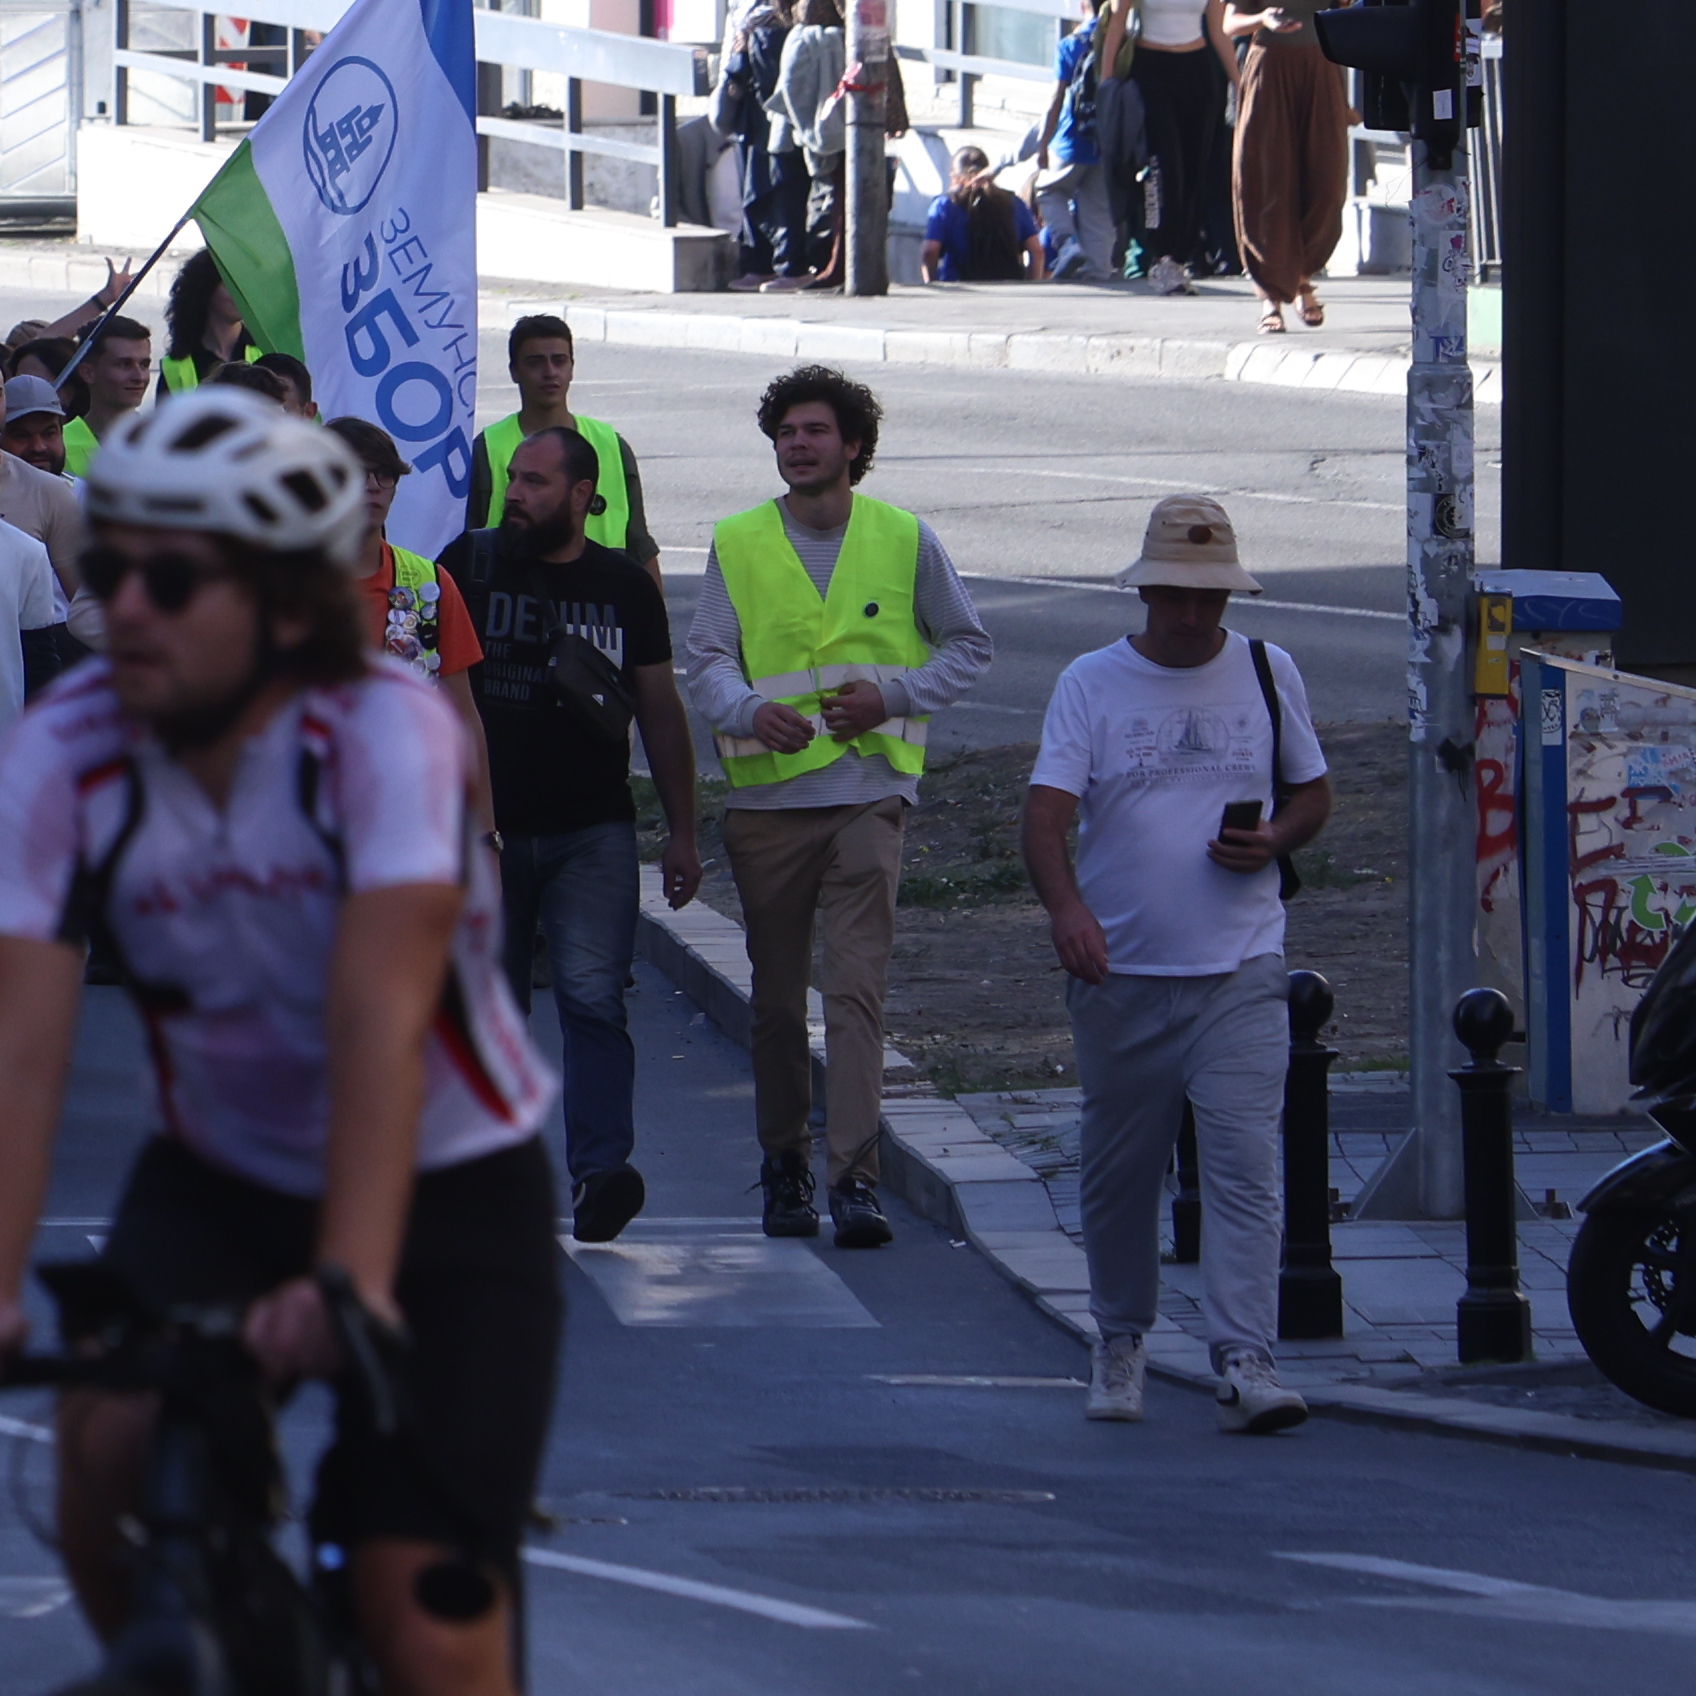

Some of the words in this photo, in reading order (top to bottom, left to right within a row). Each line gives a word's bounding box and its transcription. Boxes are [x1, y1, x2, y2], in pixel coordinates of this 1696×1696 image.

[380, 207, 477, 418] ЗЕМУНС
[340, 231, 473, 500] ЗБОР
[484, 641, 523, 660] THE
[483, 660, 554, 684] ORIGINA
[484, 679, 531, 701] BRAND
[1148, 765, 1222, 778] PROFESSIONAL
